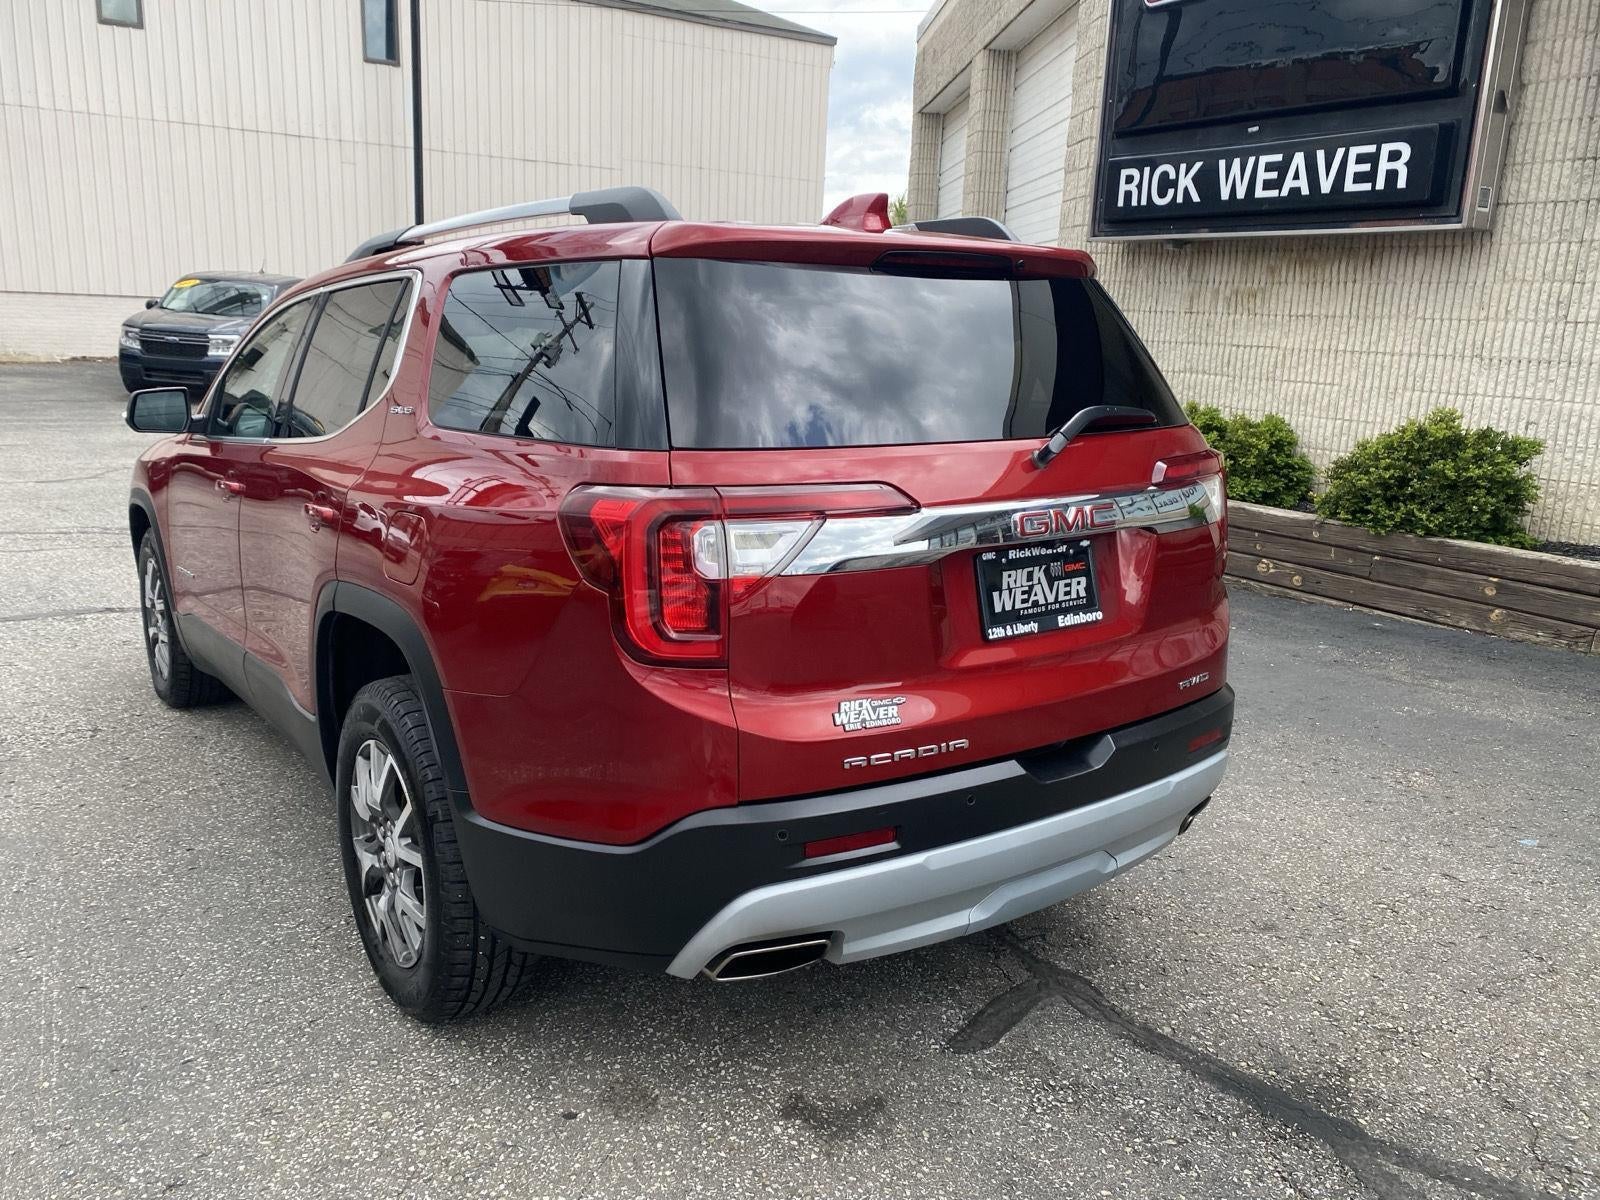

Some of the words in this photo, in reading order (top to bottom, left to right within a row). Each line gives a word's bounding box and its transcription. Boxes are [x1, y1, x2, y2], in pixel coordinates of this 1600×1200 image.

[1117, 160, 1203, 208] RICK
[1218, 141, 1412, 201] WEAVER
[1014, 502, 1117, 539] GMC
[982, 551, 996, 561] GMC
[1064, 561, 1087, 572] GMC
[1002, 564, 1047, 590] RICK
[992, 576, 1088, 614] WEAVER
[1020, 604, 1046, 616] FAMOUS
[1047, 600, 1060, 611] FOR
[1061, 597, 1087, 609] SERVICE
[1057, 610, 1103, 628] Edinboro
[988, 626, 1006, 639] 12th
[1005, 624, 1013, 636] &
[1013, 620, 1039, 635] Liberty
[1178, 672, 1210, 690] AWD
[840, 698, 872, 713] RICK
[870, 698, 893, 707] GMC
[833, 705, 899, 726] WEAVER
[845, 722, 862, 732] ERIE
[865, 717, 902, 729] EDINBORO
[843, 738, 970, 770] ACADIA
